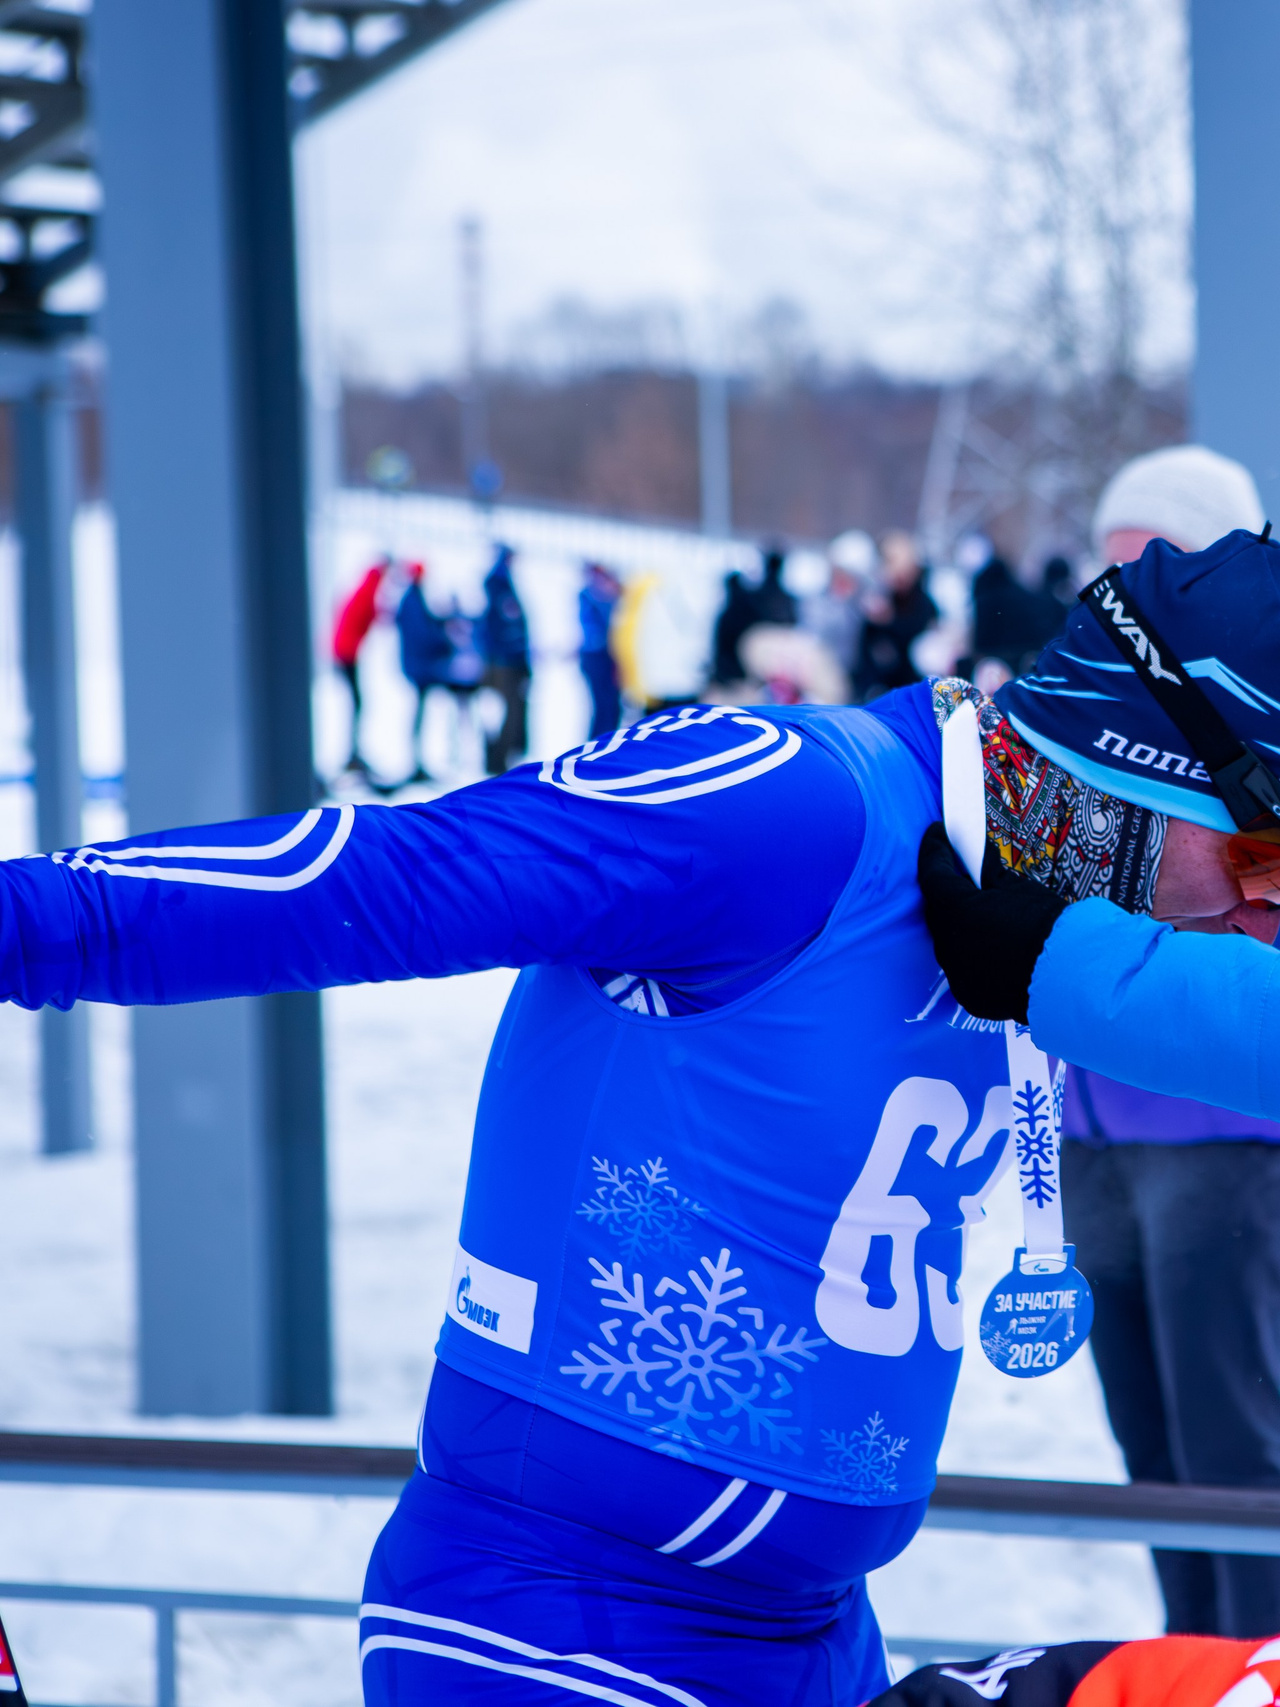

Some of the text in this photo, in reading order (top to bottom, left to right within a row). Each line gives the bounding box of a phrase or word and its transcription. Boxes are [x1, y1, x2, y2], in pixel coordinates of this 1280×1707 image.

[1118, 838, 1138, 904] NATIONAL
[994, 1290, 1078, 1313] ЗА УЧАСТИЕ
[1006, 1341, 1061, 1370] 2026
